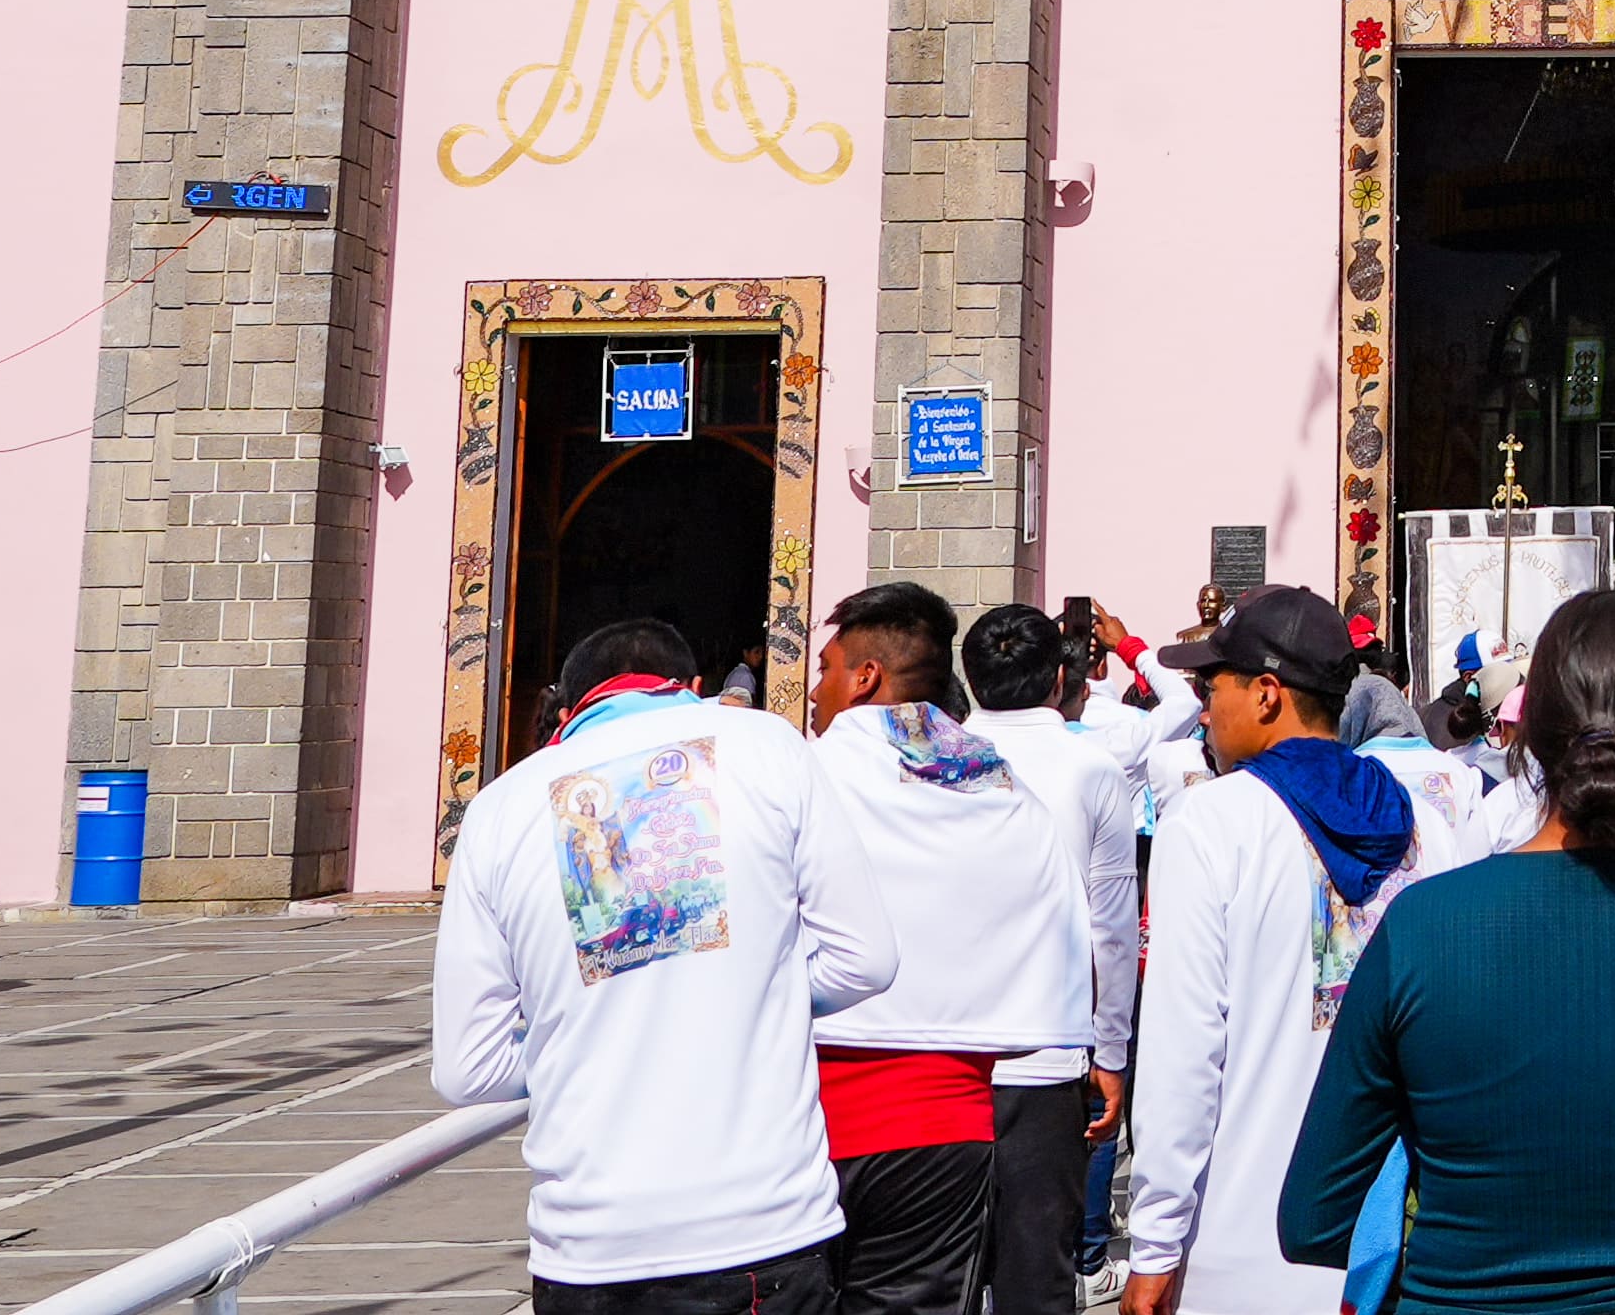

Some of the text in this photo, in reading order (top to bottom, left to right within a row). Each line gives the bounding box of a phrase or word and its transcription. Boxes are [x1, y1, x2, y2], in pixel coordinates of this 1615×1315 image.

[616, 389, 679, 411] SALIDA
[933, 420, 976, 433] Santuario
[942, 434, 971, 449] Virgen
[655, 754, 683, 776] 20
